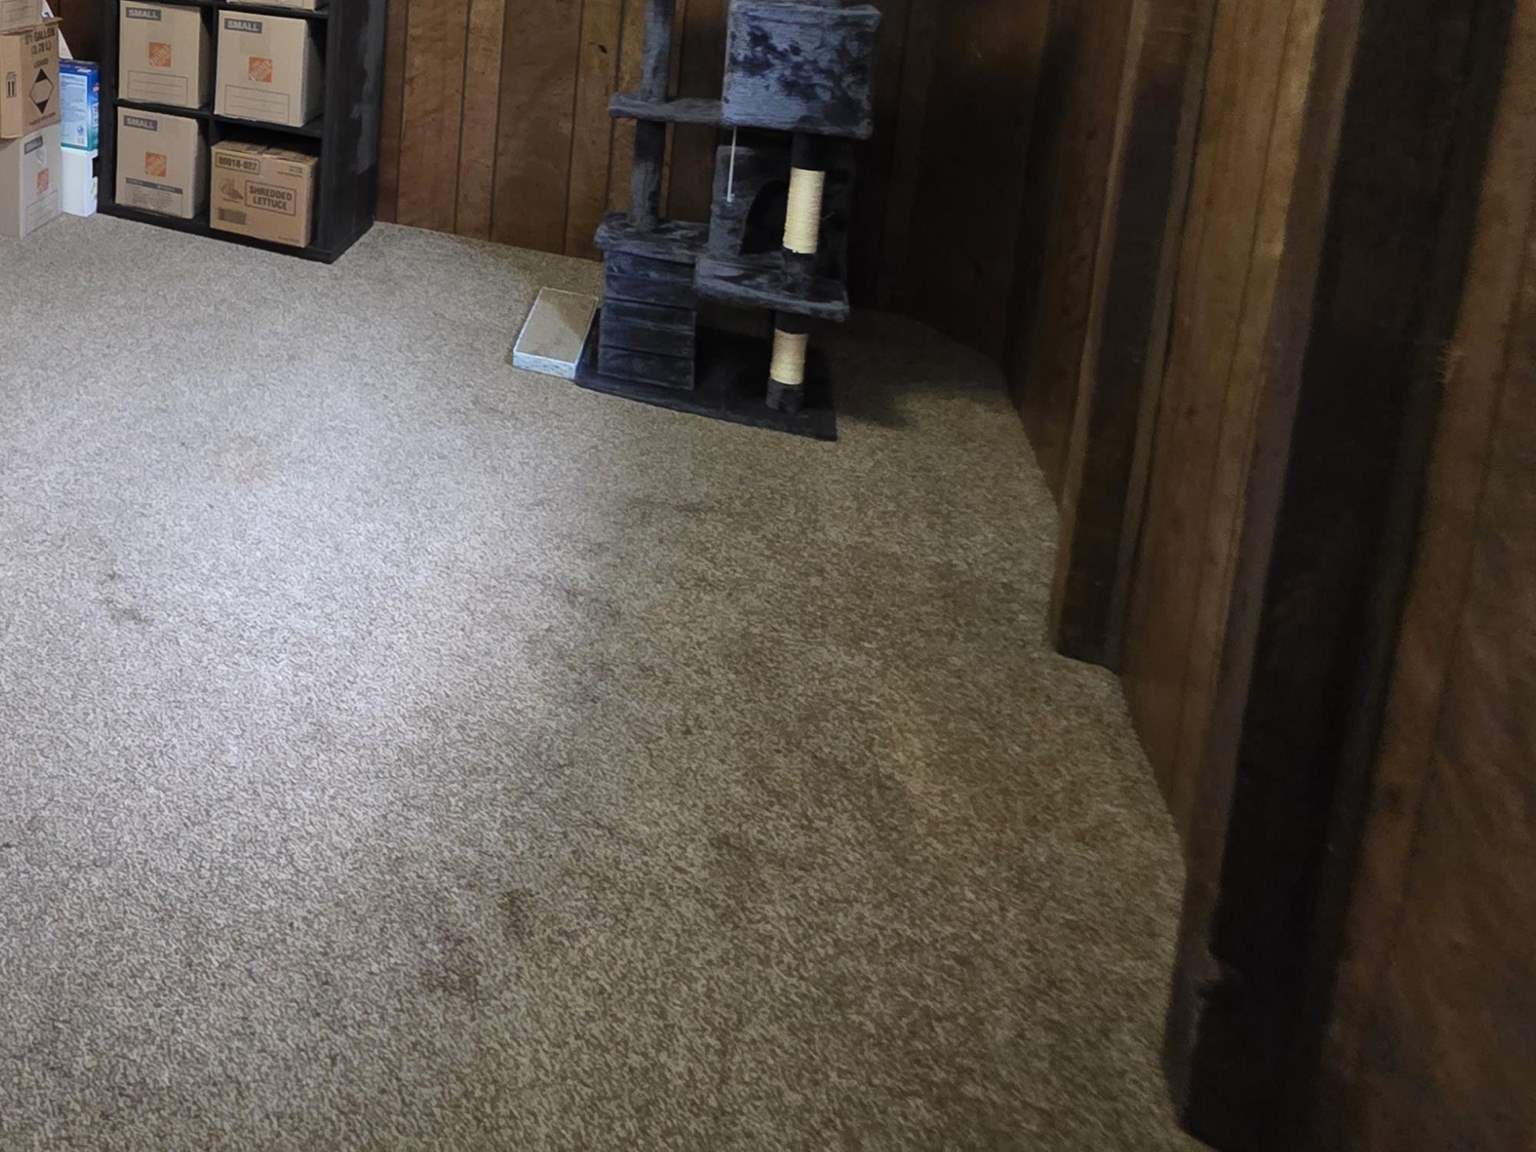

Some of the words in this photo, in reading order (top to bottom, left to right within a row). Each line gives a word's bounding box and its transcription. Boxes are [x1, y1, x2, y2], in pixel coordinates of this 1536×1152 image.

[128, 8, 159, 19] SMALL
[227, 20, 260, 31] SMALL
[249, 186, 292, 201] SHREDDED
[253, 196, 288, 210] LETTUCE
